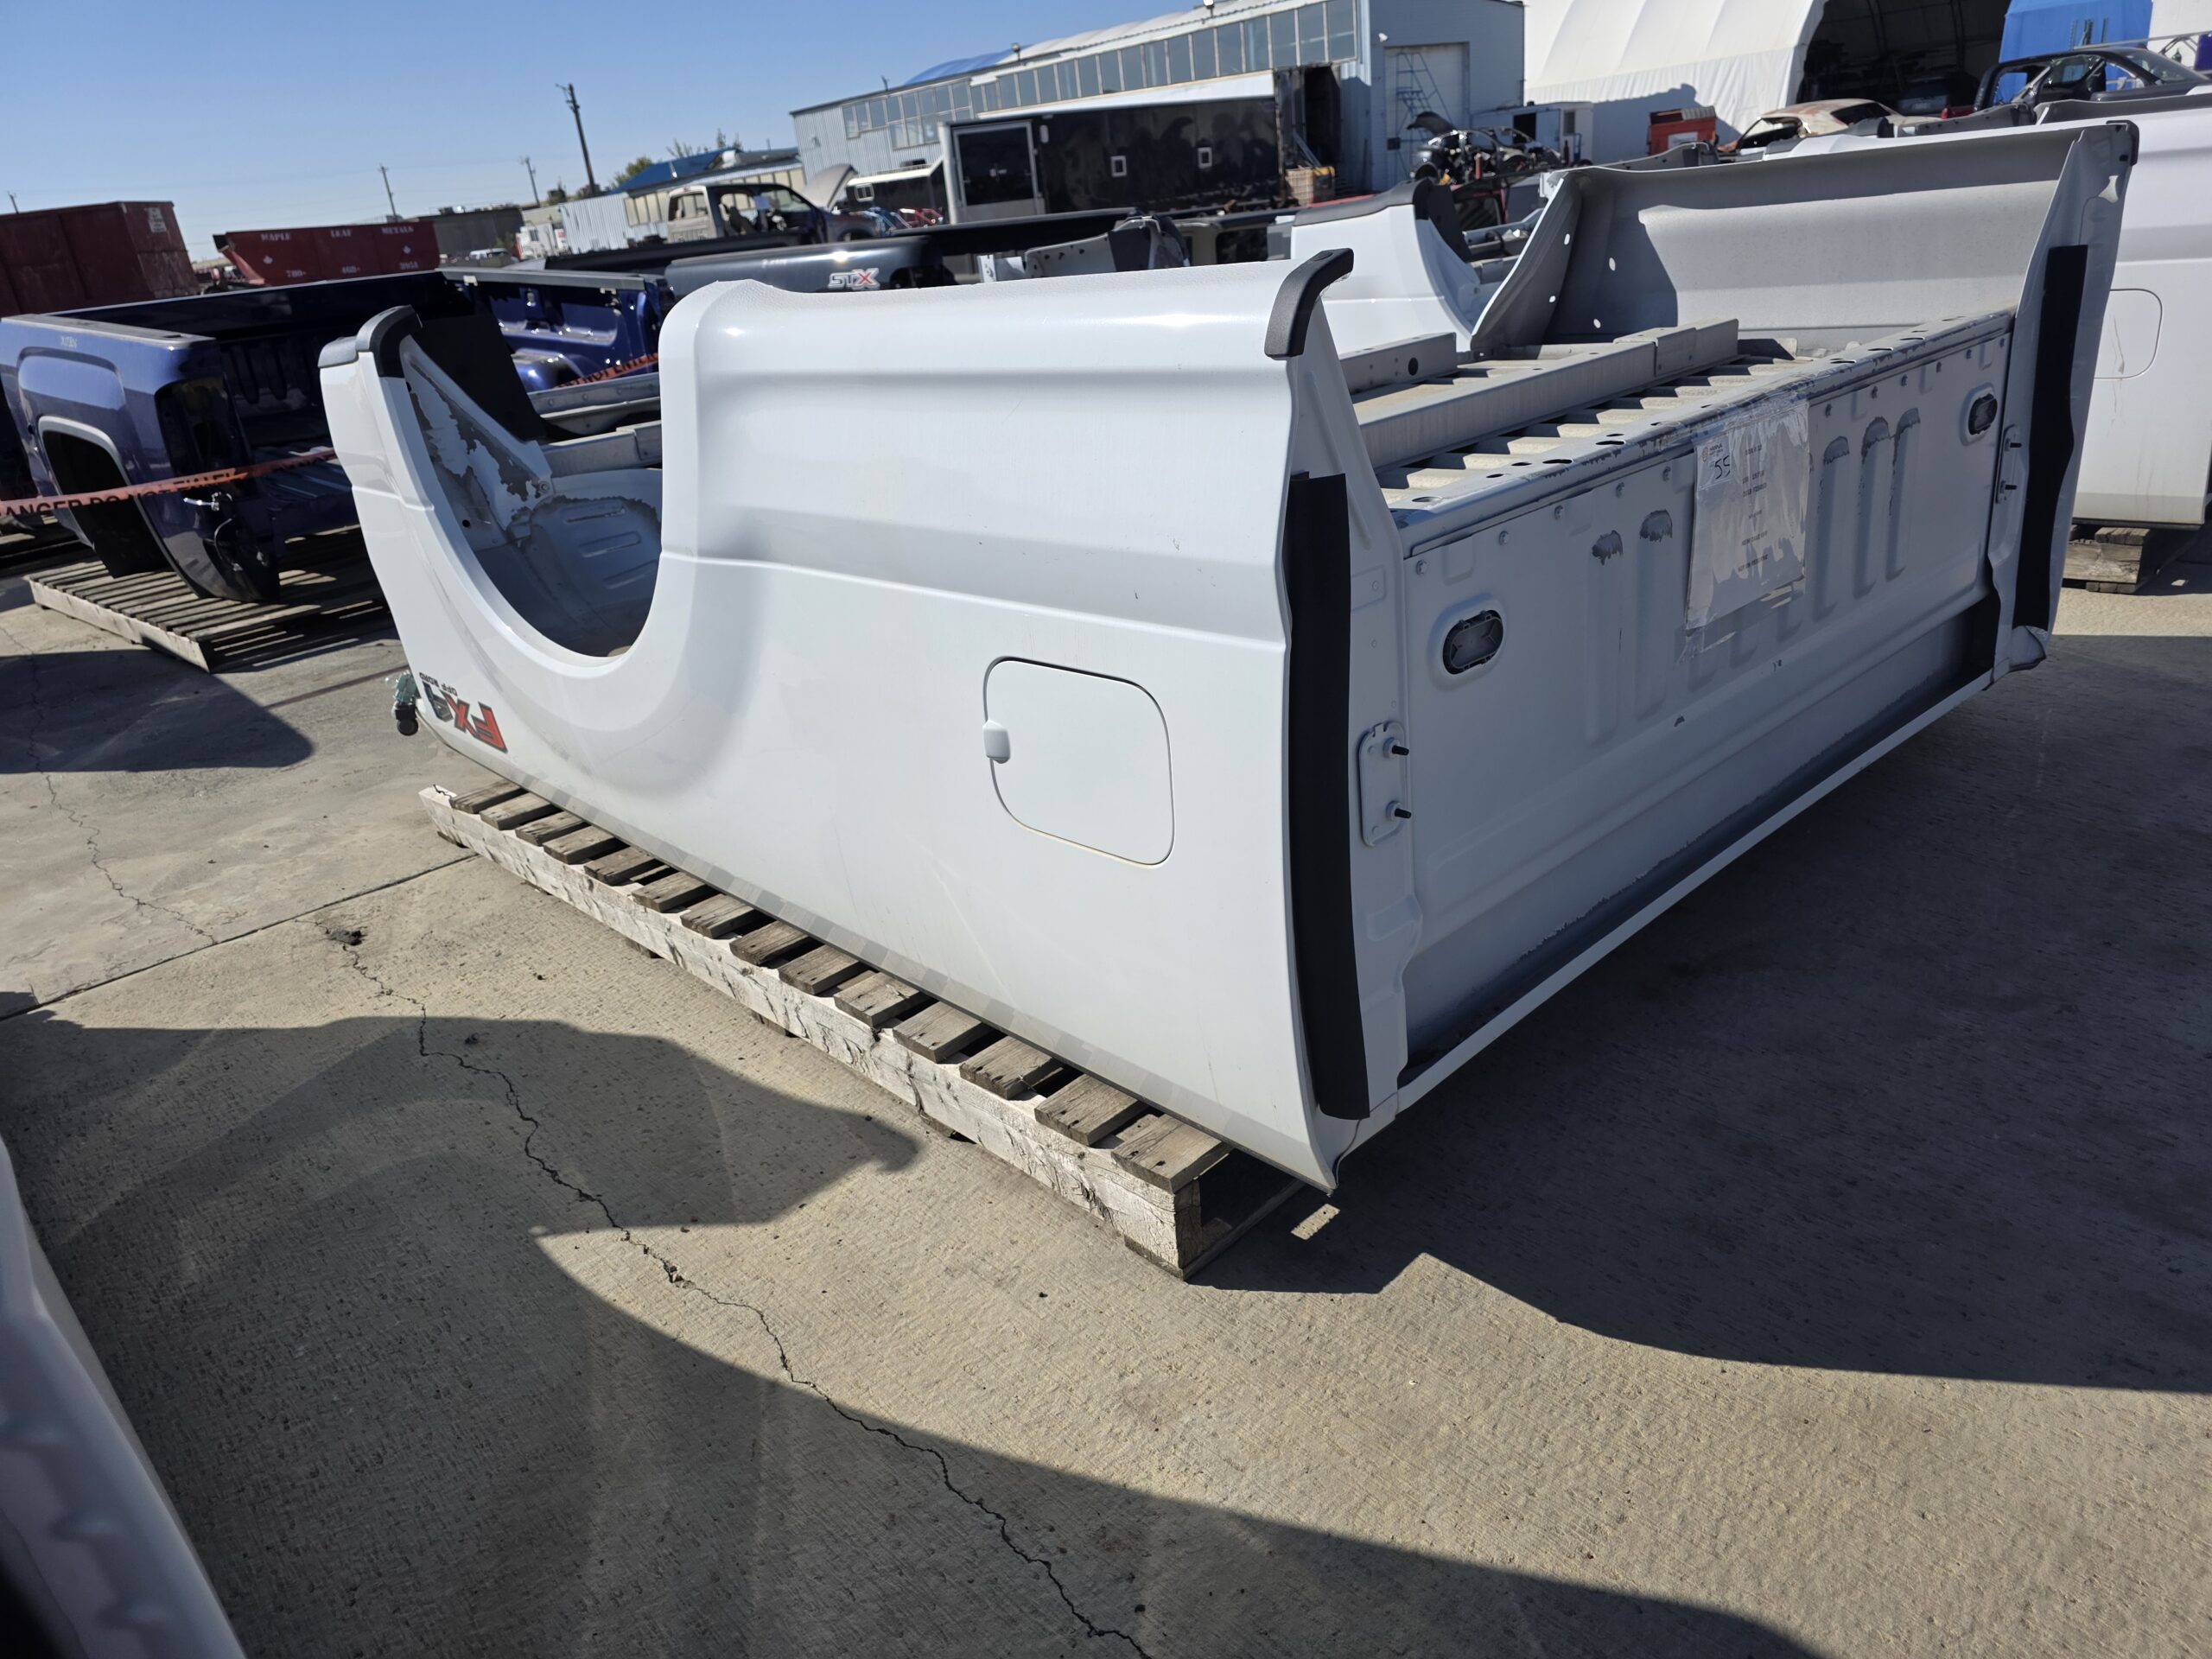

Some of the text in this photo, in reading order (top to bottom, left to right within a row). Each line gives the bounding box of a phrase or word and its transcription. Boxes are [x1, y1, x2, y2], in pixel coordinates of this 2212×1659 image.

[260, 232, 291, 241] MAPLE
[330, 229, 353, 238] LEAF
[828, 268, 880, 290] STX
[0, 499, 84, 517] ANGER
[422, 680, 509, 754] FX4
